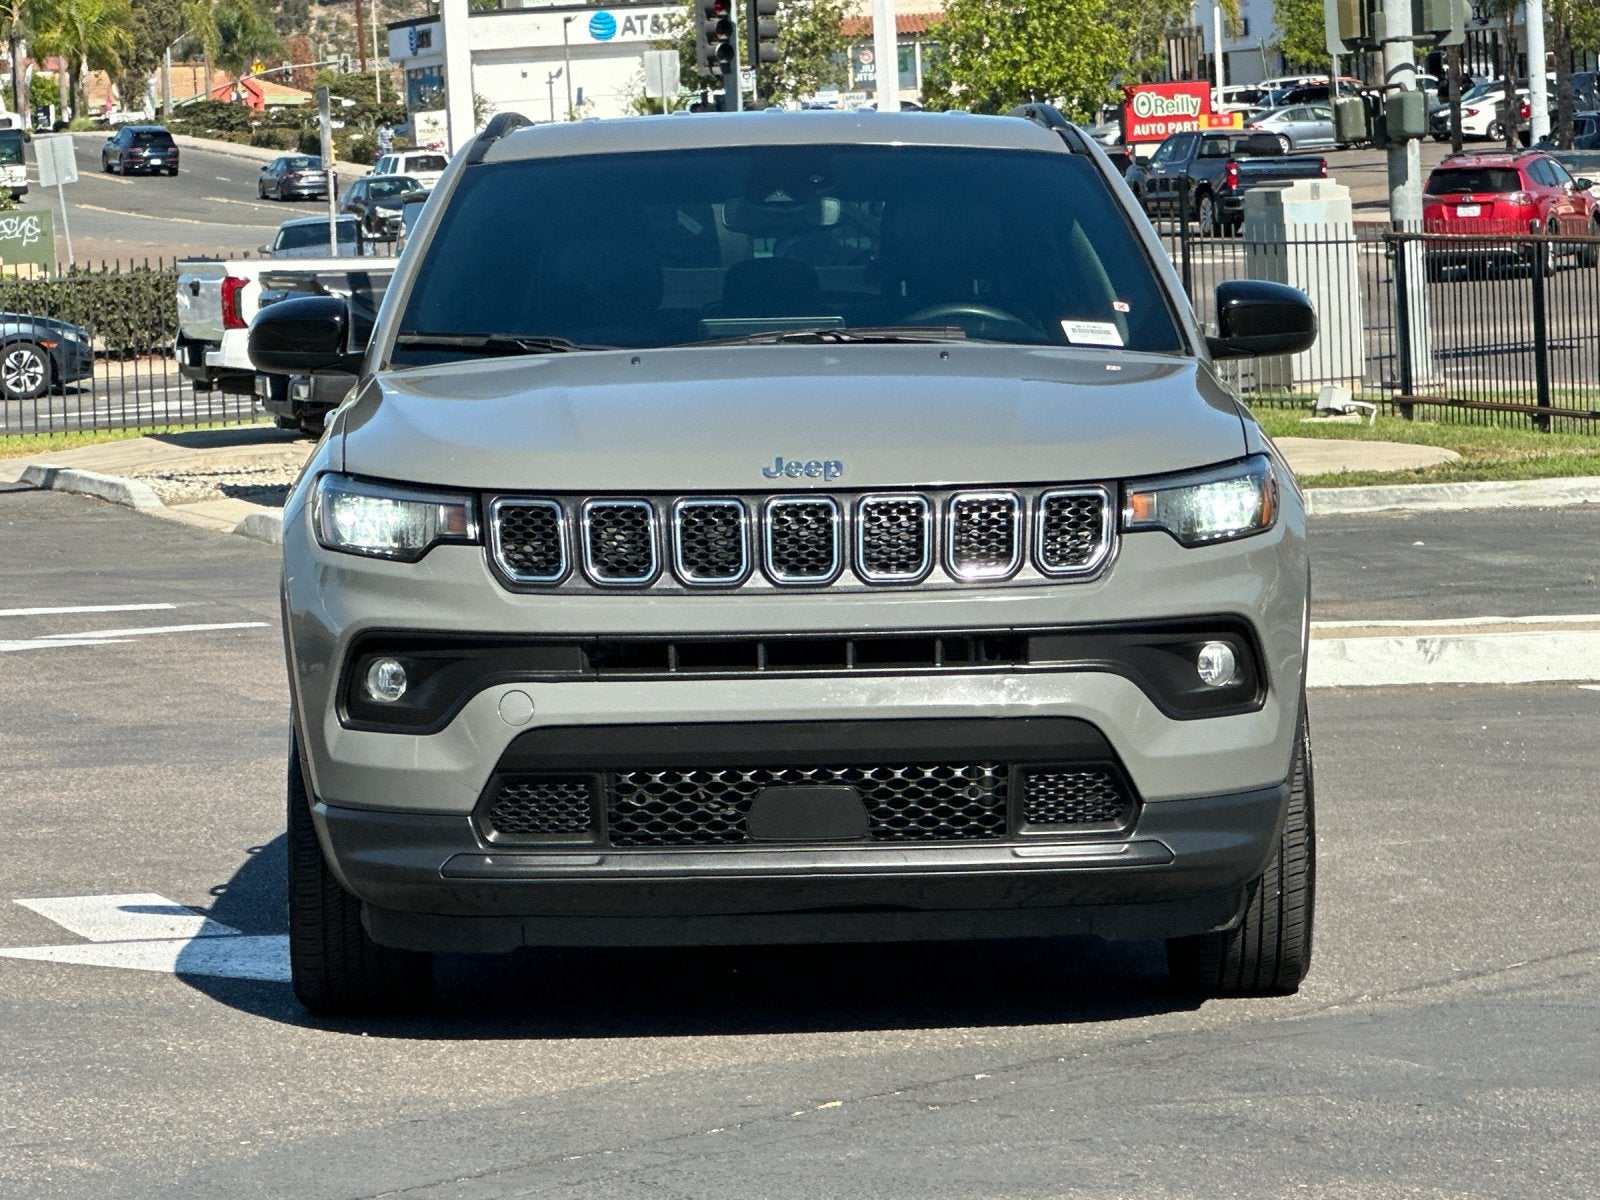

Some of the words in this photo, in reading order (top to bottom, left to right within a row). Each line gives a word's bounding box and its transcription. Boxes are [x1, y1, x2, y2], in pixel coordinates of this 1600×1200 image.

[621, 13, 677, 36] AT&T
[854, 73, 878, 82] JITS
[859, 64, 875, 73] JIU
[1134, 91, 1201, 117] O'Reilly
[1133, 123, 1163, 136] AUTO
[1168, 121, 1199, 134] PART
[762, 457, 844, 482] Jeep
